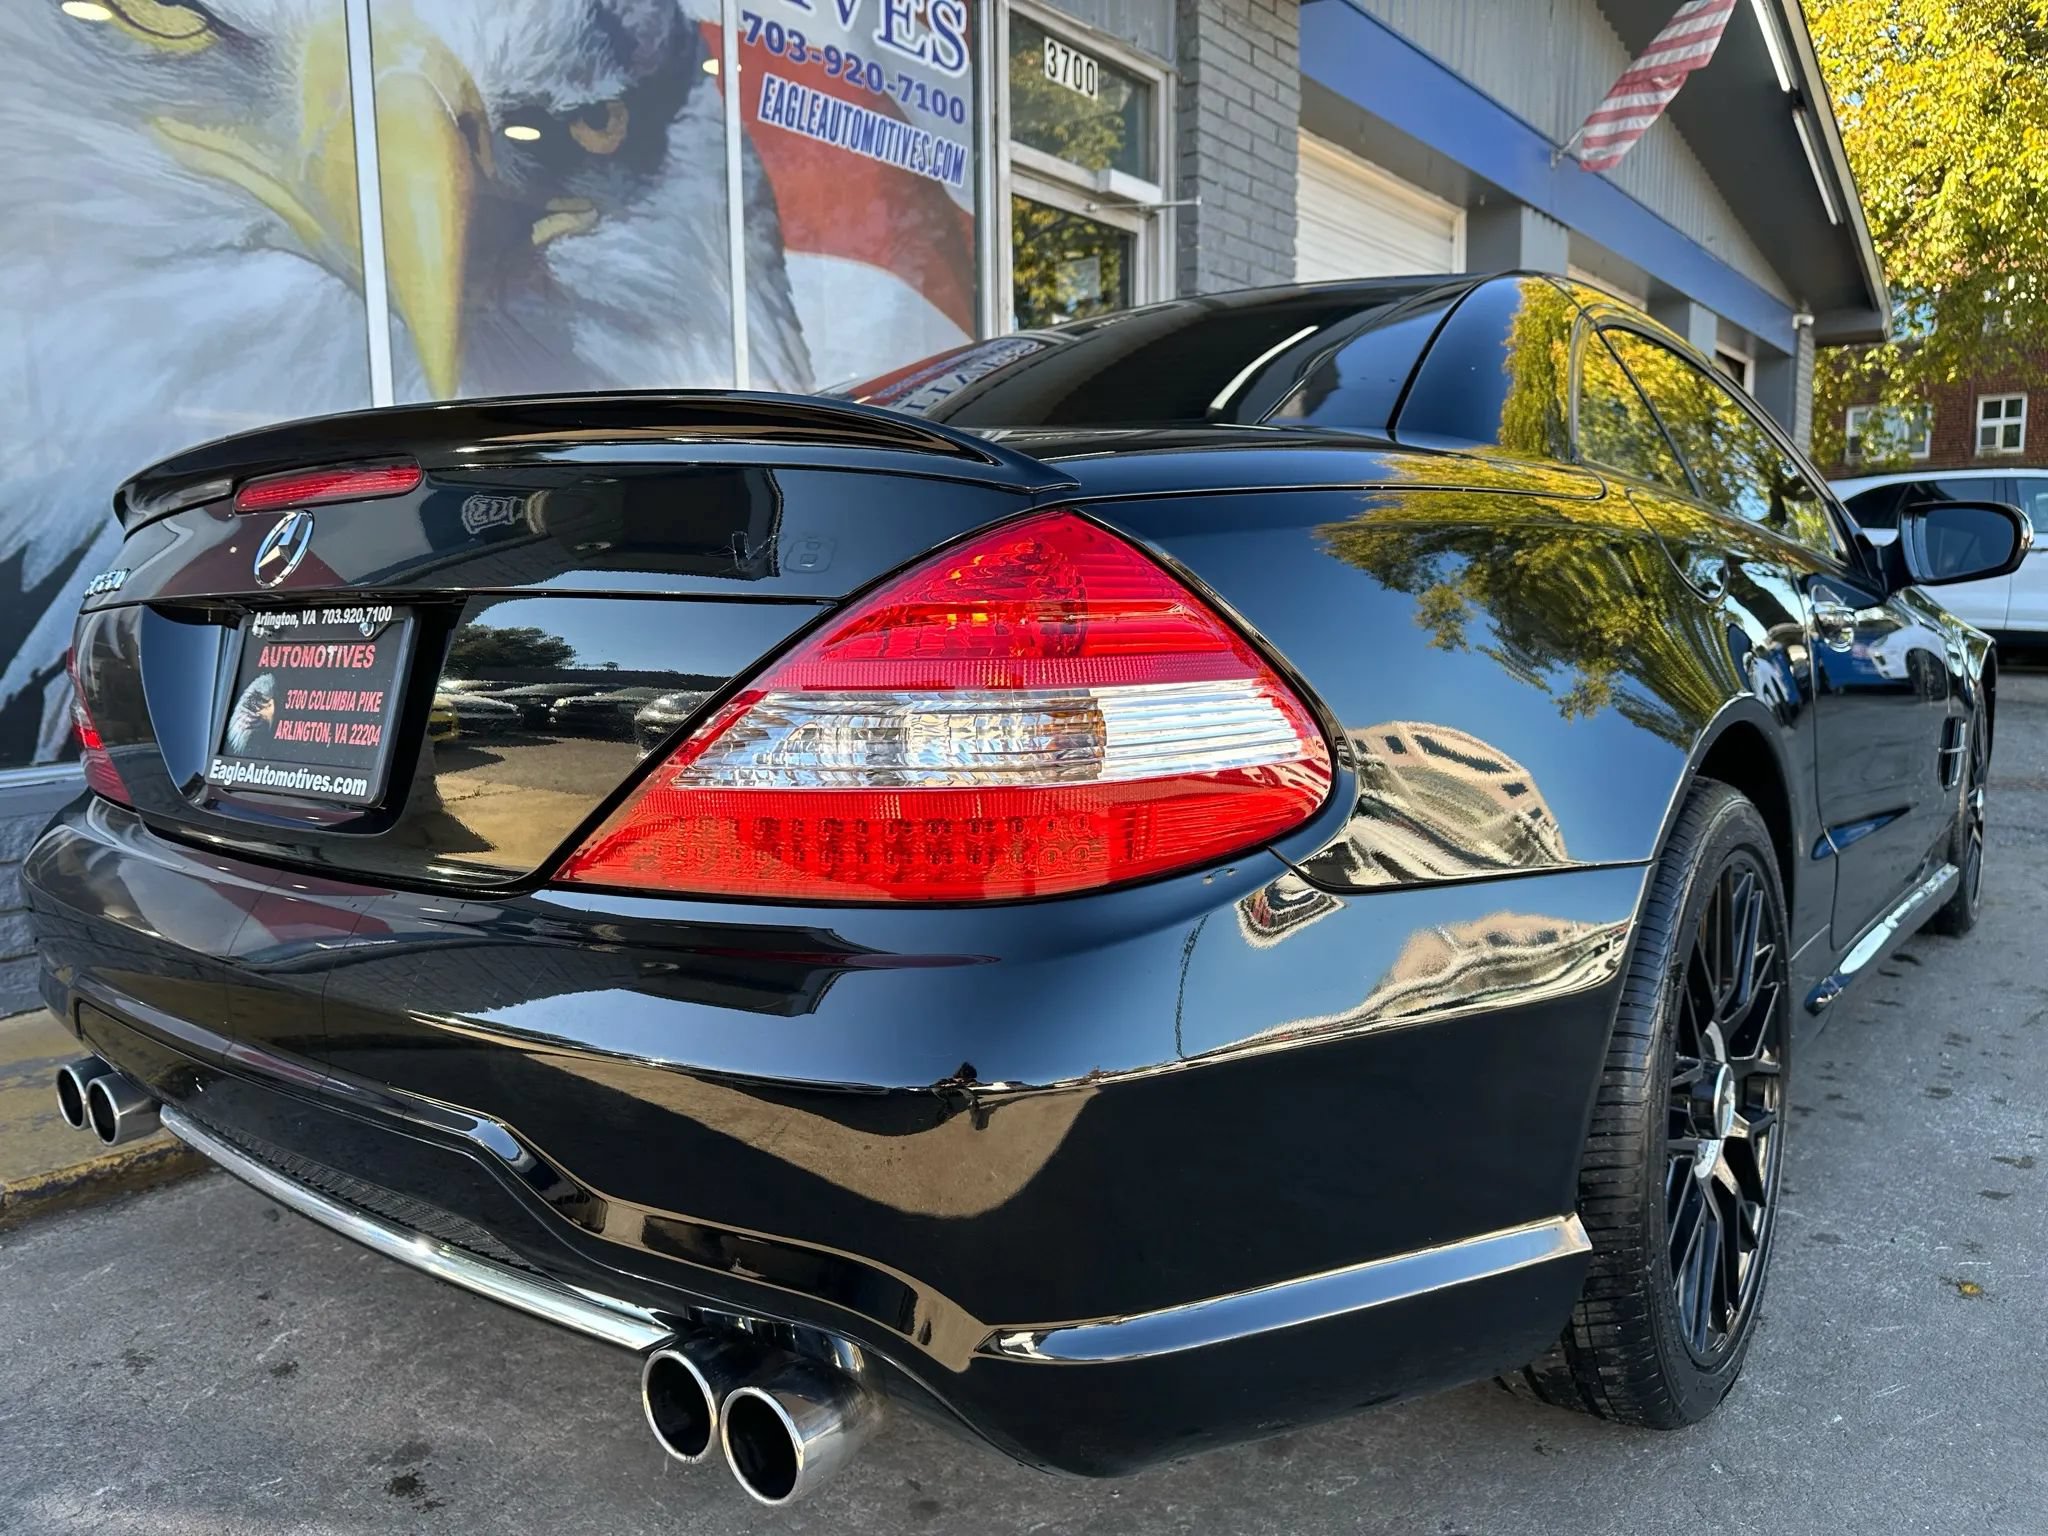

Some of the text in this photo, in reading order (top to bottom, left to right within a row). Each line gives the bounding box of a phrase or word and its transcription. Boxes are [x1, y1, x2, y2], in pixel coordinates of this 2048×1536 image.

[785, 0, 967, 72] ES
[742, 10, 966, 125] 703-920-7100
[1047, 41, 1095, 96] 3700
[760, 76, 967, 186] EAGLEAUTOMOTIVES.COM
[253, 605, 393, 629] Arlington, VA 703.920.7100
[258, 645, 375, 668] AUTOMOTIVES
[285, 689, 383, 712] 3700 COLUMBIA PIKE
[274, 719, 382, 747] ARLINGTON, VA 22204
[209, 759, 368, 796] EagleAutomotives.com
